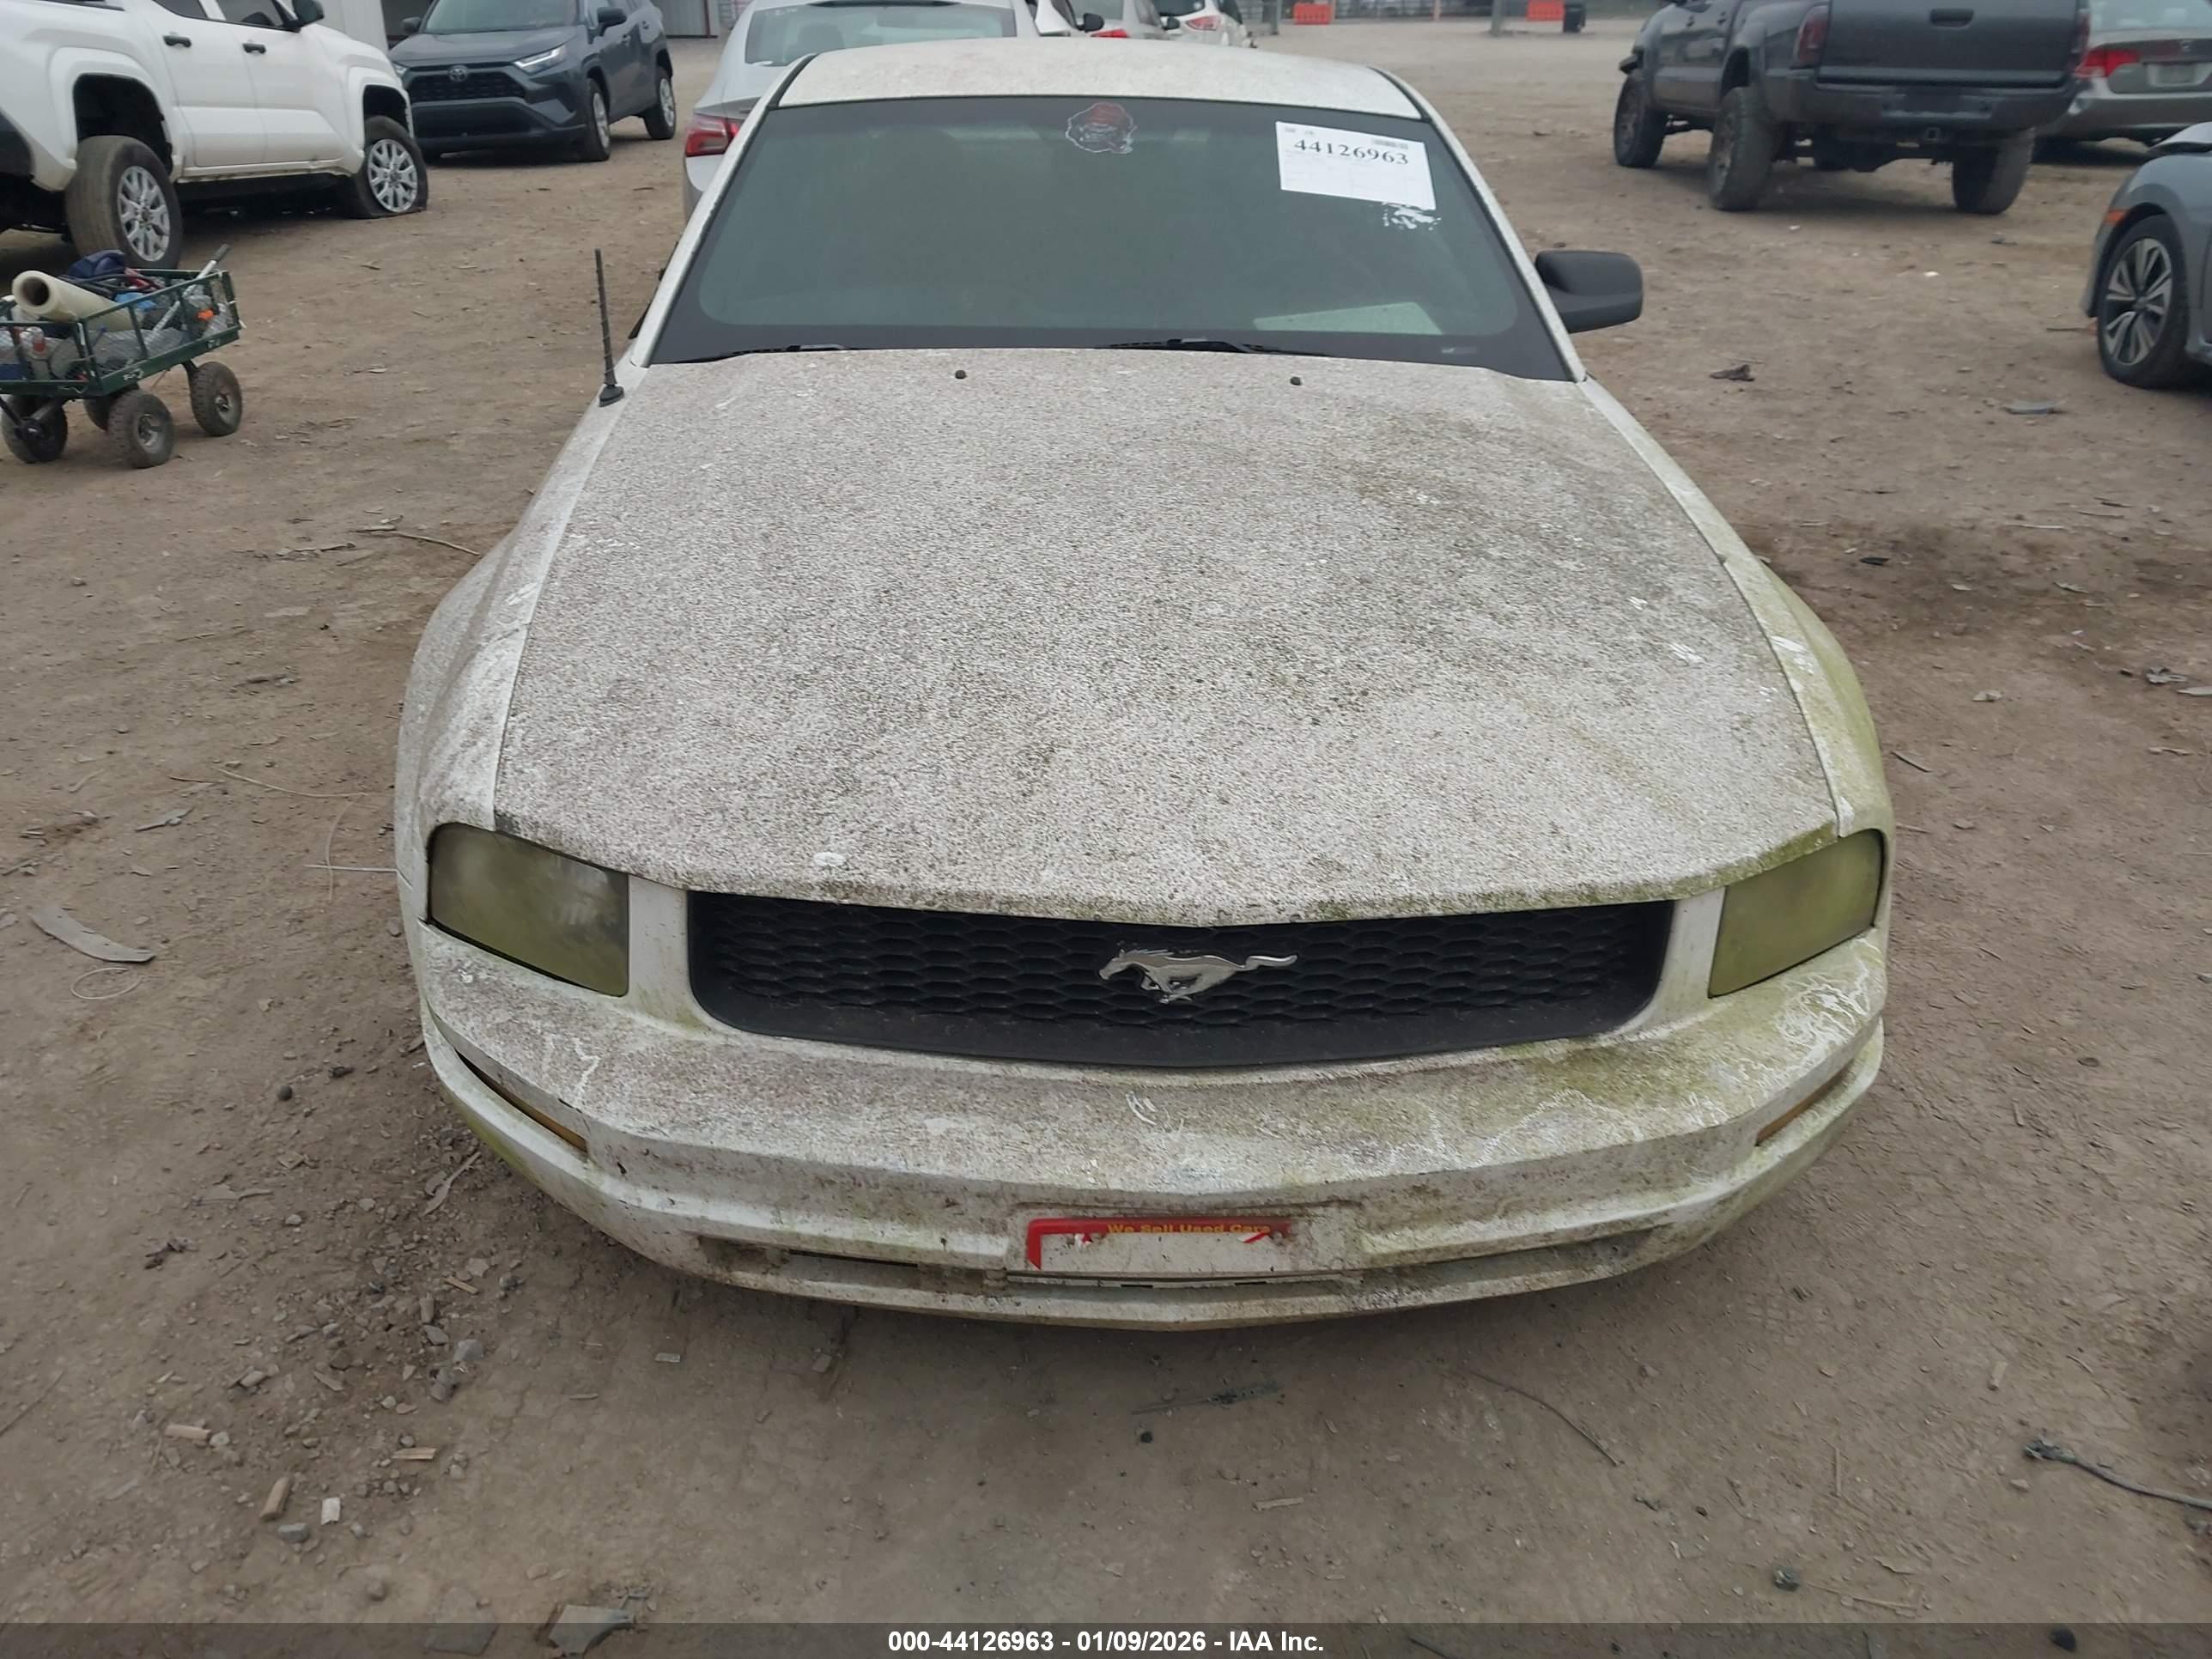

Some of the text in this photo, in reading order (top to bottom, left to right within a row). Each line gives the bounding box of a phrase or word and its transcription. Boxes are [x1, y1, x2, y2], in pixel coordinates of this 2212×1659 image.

[1294, 138, 1409, 166] 44126963
[1107, 1224, 1134, 1234] We
[1140, 1224, 1174, 1234] Sell
[1179, 1224, 1224, 1234] Used
